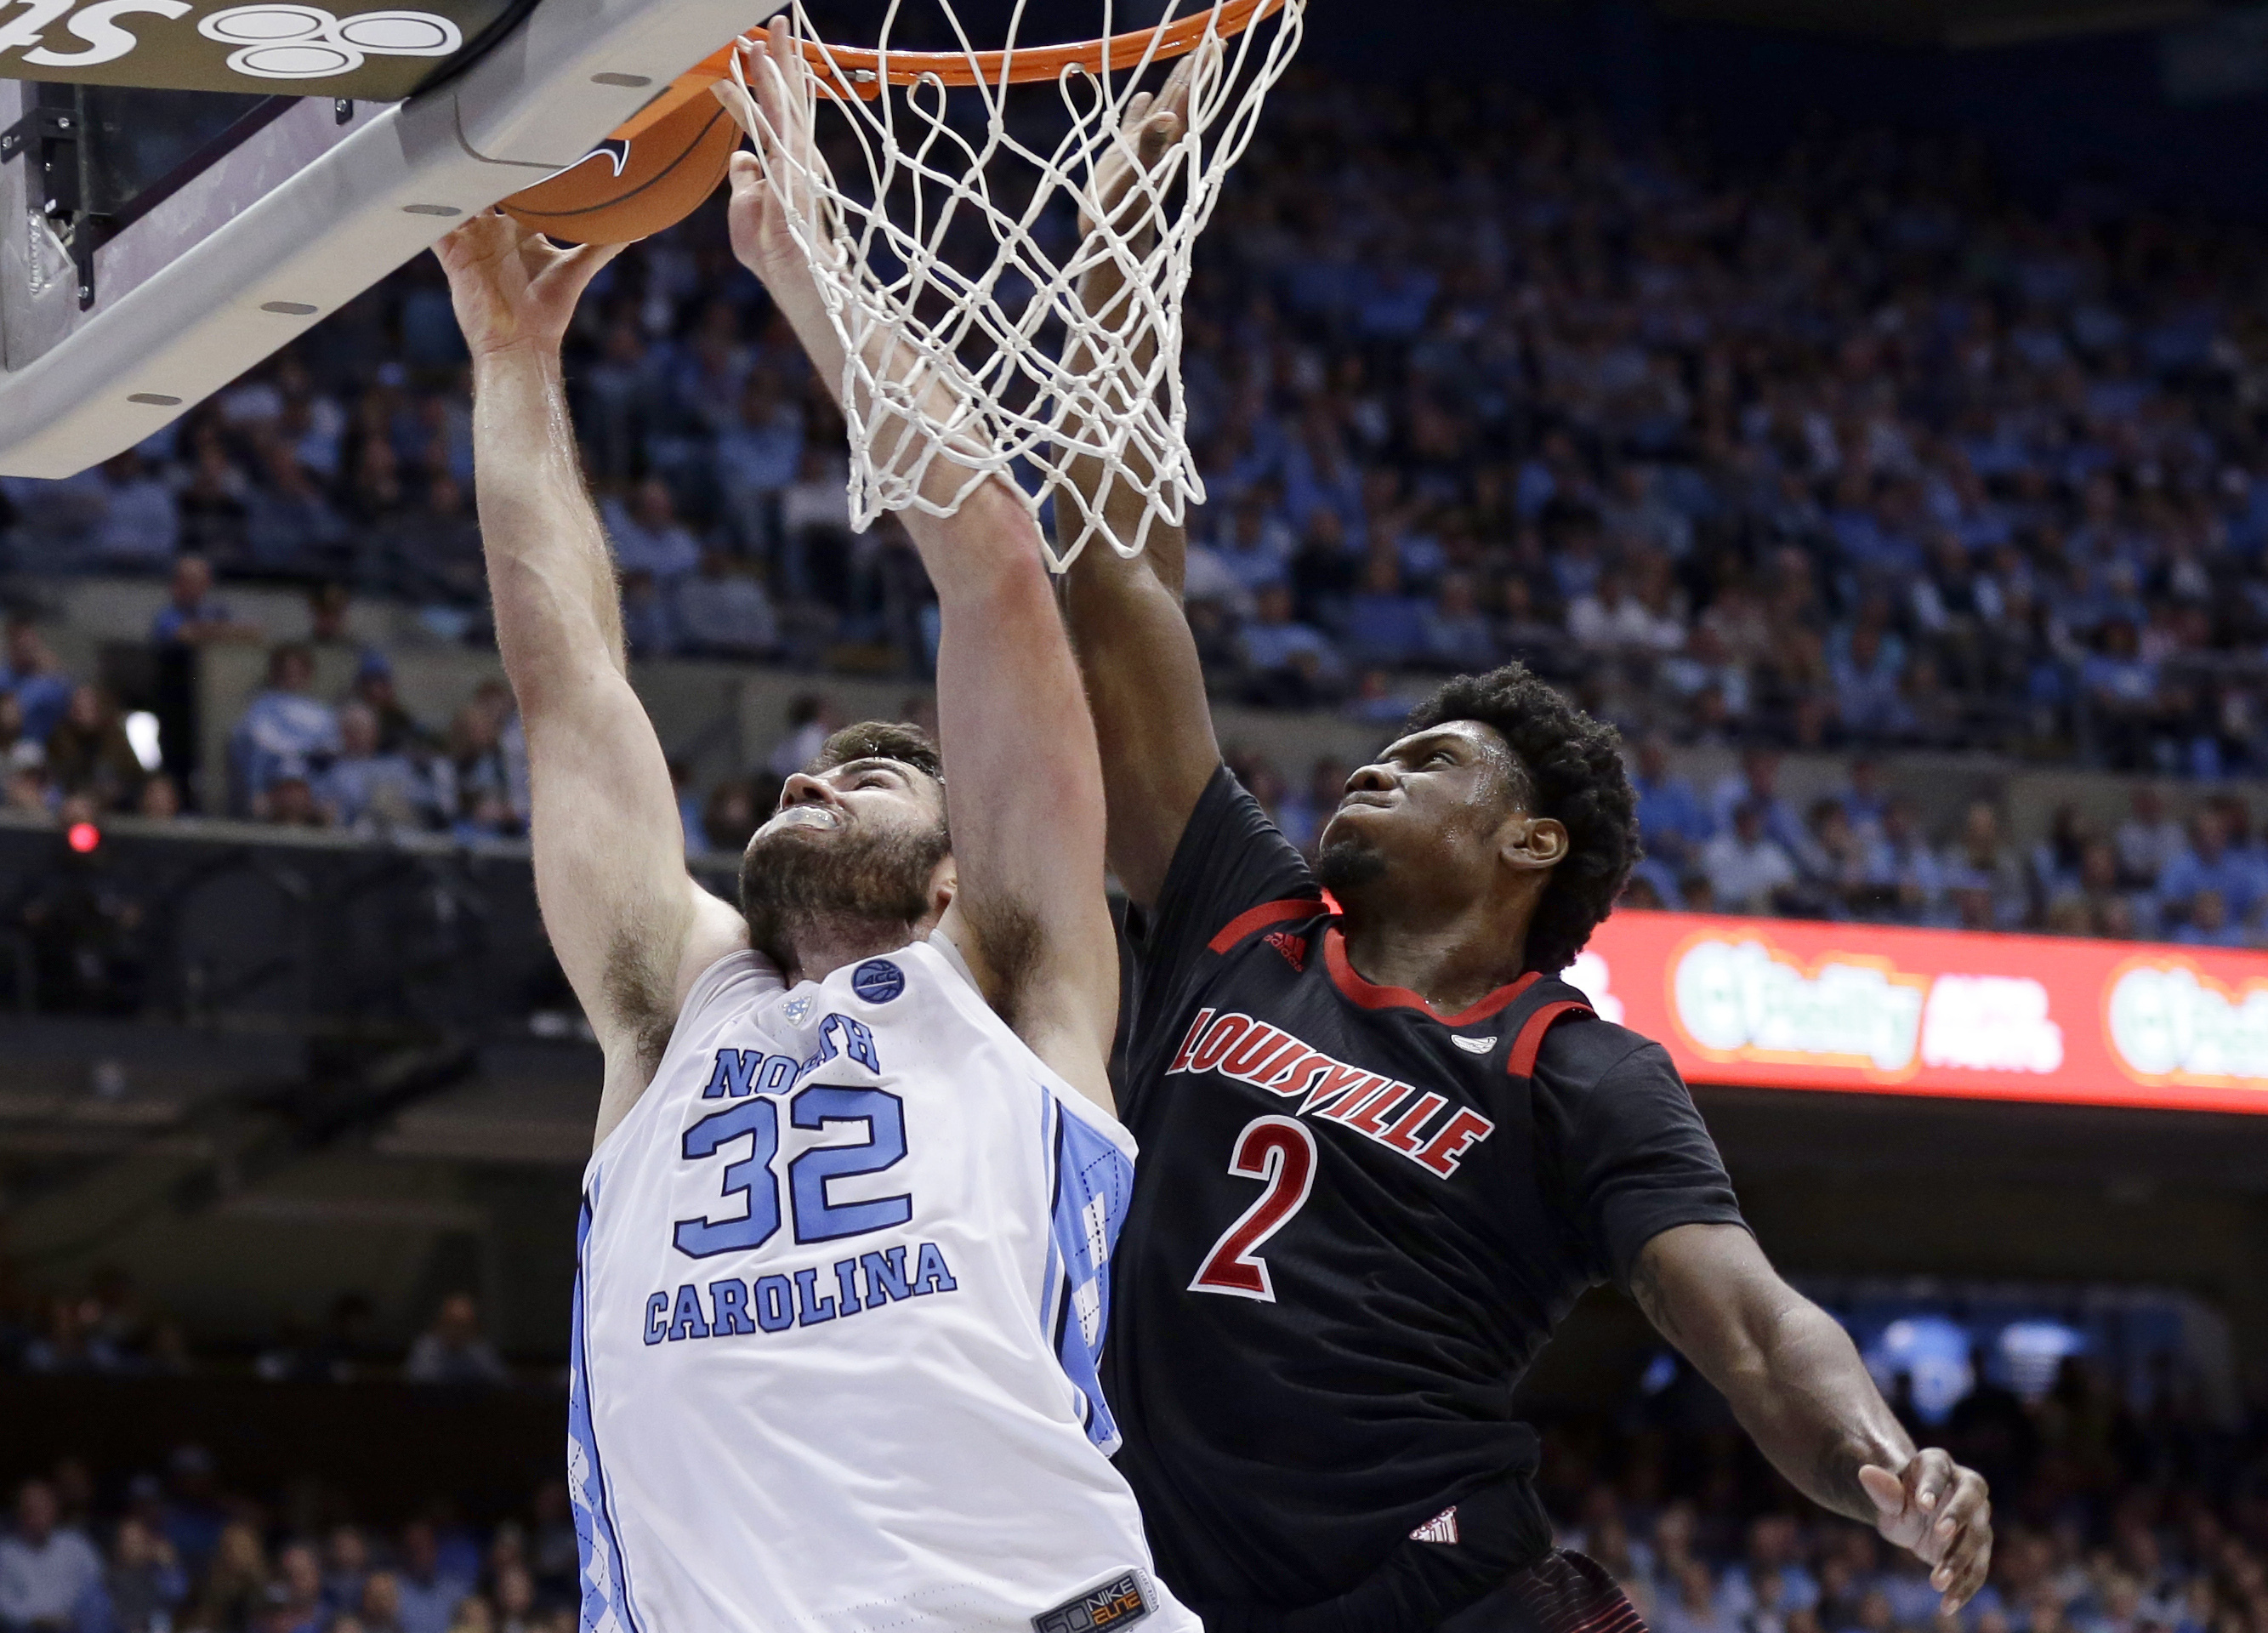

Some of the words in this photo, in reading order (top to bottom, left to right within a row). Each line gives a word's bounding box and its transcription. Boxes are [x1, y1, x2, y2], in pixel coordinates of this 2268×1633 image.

[861, 969, 900, 987] ACC
[1165, 1007, 1495, 1181] LOUISVILLE
[673, 1083, 912, 1260] 32
[1187, 1114, 1318, 1303] 2
[643, 1243, 958, 1346] CAROLINA
[1086, 1578, 1135, 1611] NIKE
